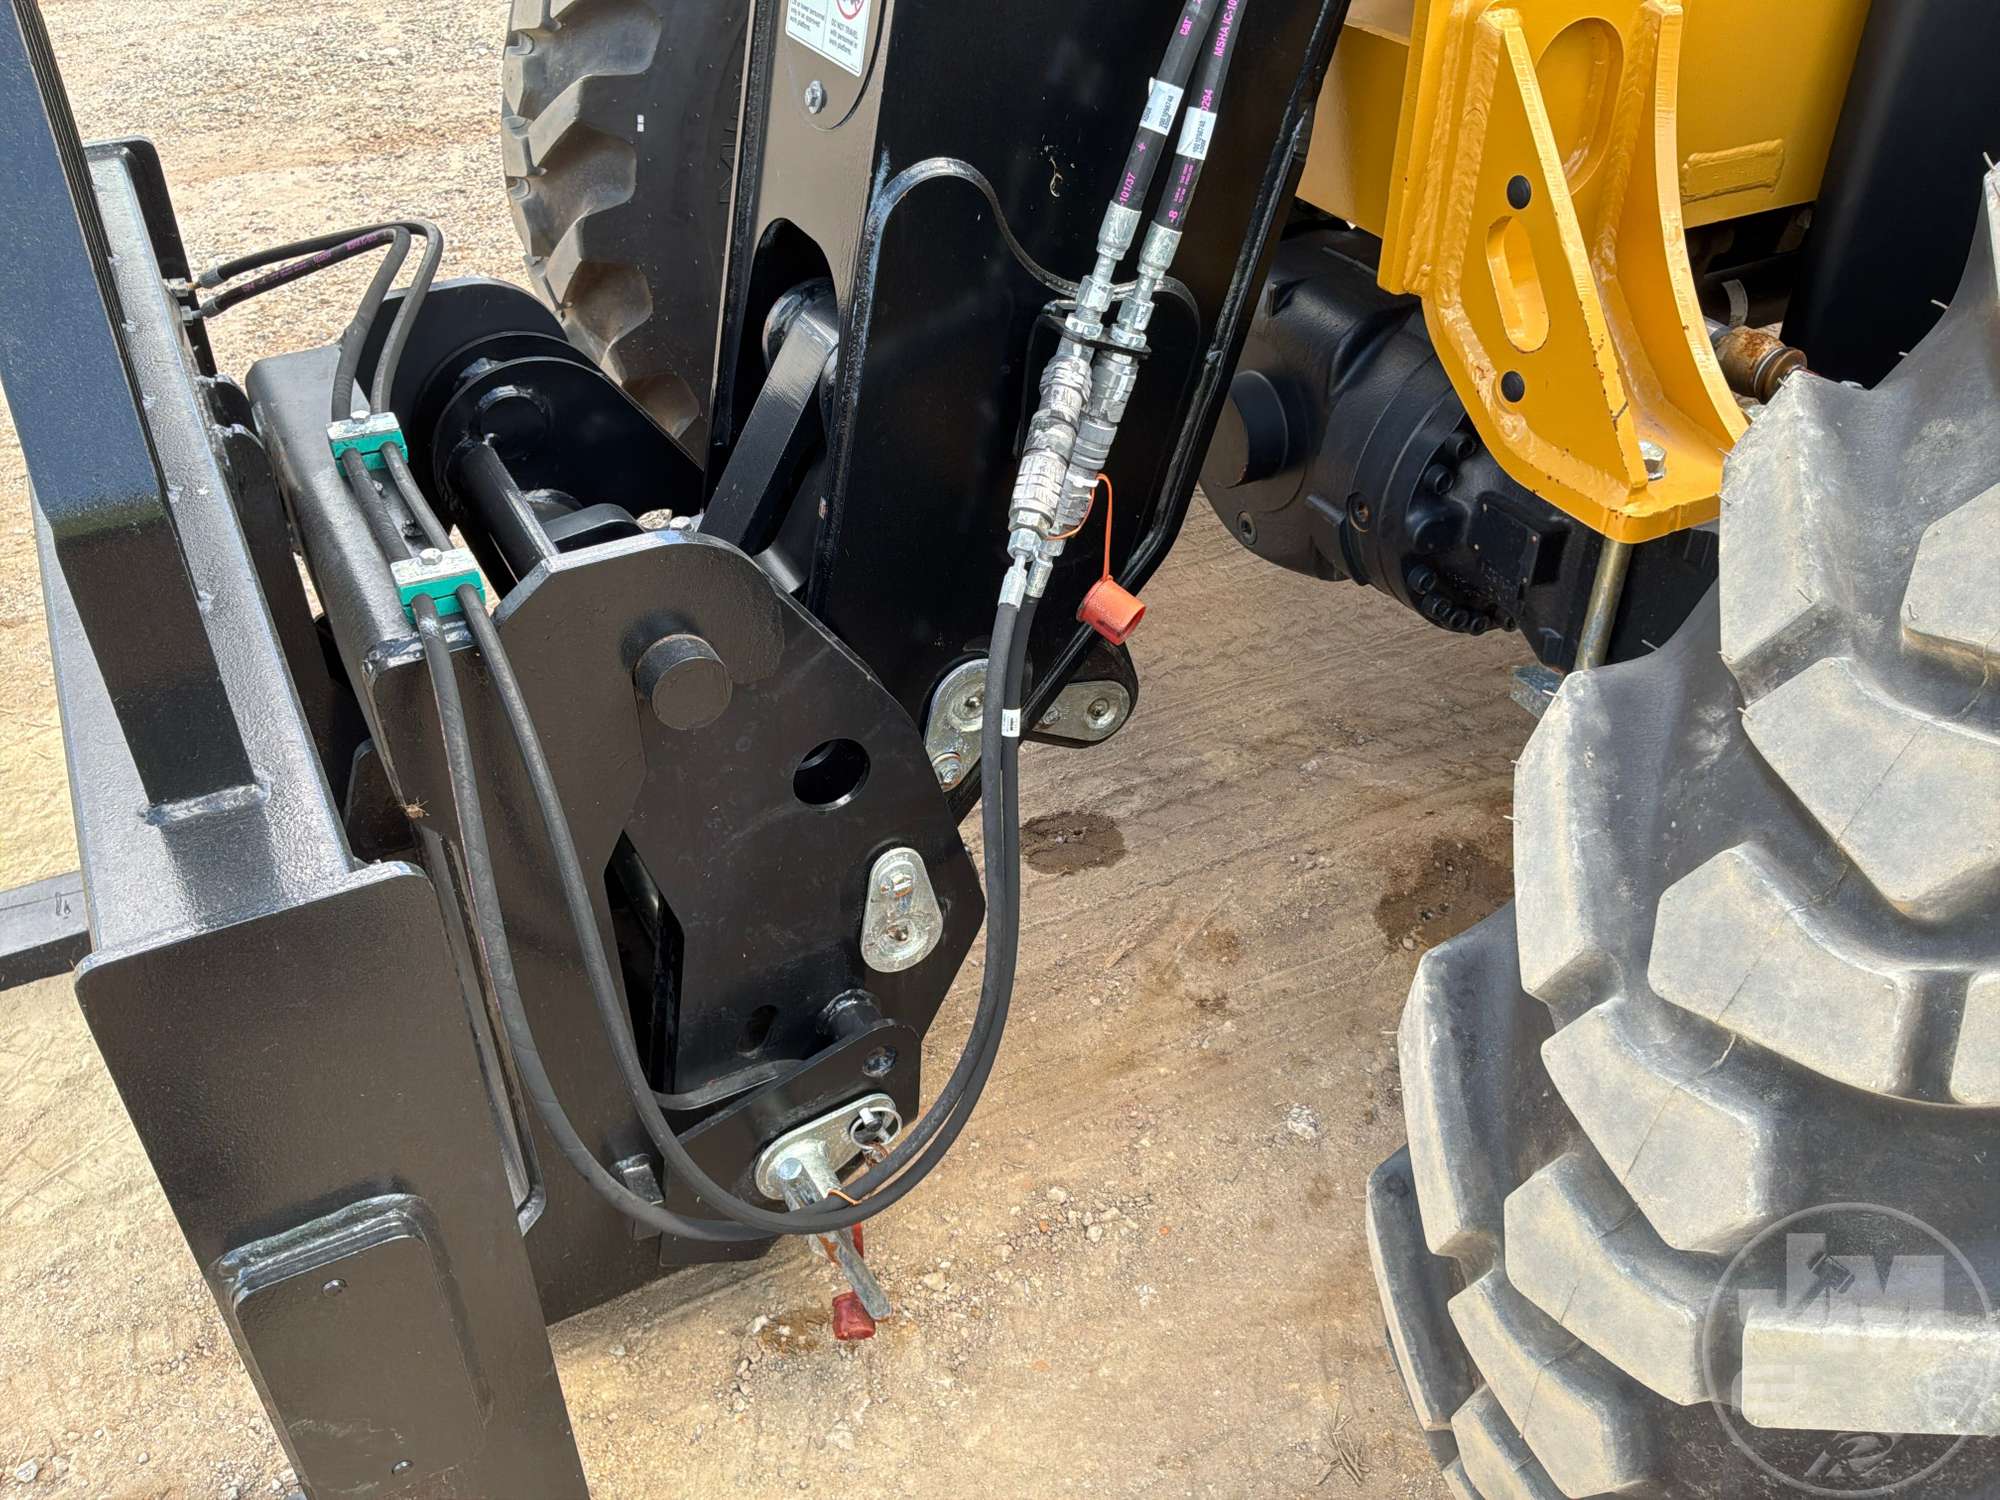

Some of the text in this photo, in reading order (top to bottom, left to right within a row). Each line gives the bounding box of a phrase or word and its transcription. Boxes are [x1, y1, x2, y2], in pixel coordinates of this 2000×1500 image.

[1180, 16, 1192, 36] CAT
[1213, 0, 1240, 57] MSHA IC-10
